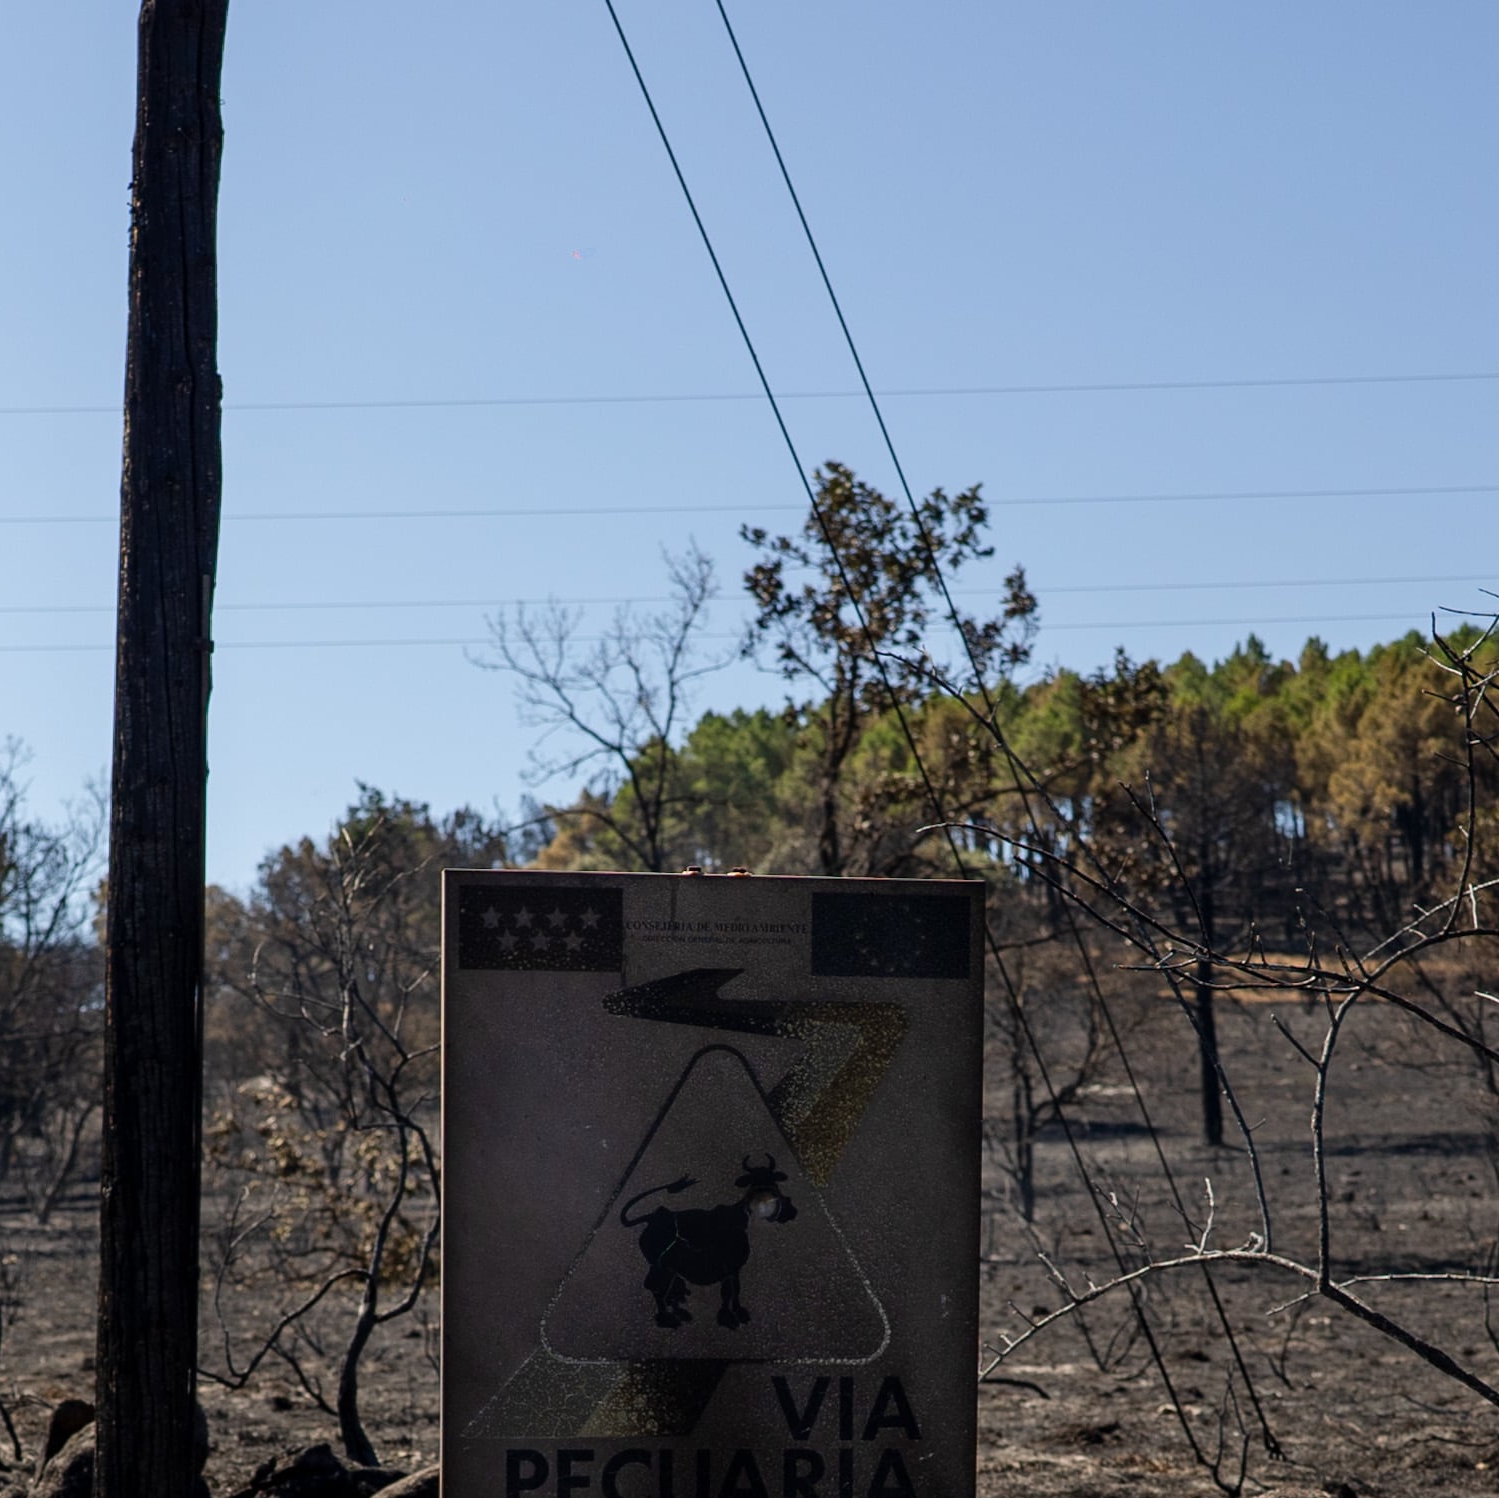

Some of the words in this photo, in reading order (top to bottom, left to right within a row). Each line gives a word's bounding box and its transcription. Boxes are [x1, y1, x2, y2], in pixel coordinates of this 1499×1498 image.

[625, 921, 694, 932] CONSEJERIA
[697, 922, 712, 932] DE
[714, 922, 749, 933] MEDIO
[751, 923, 808, 934] AMBIENTE
[771, 1375, 922, 1440] VIA
